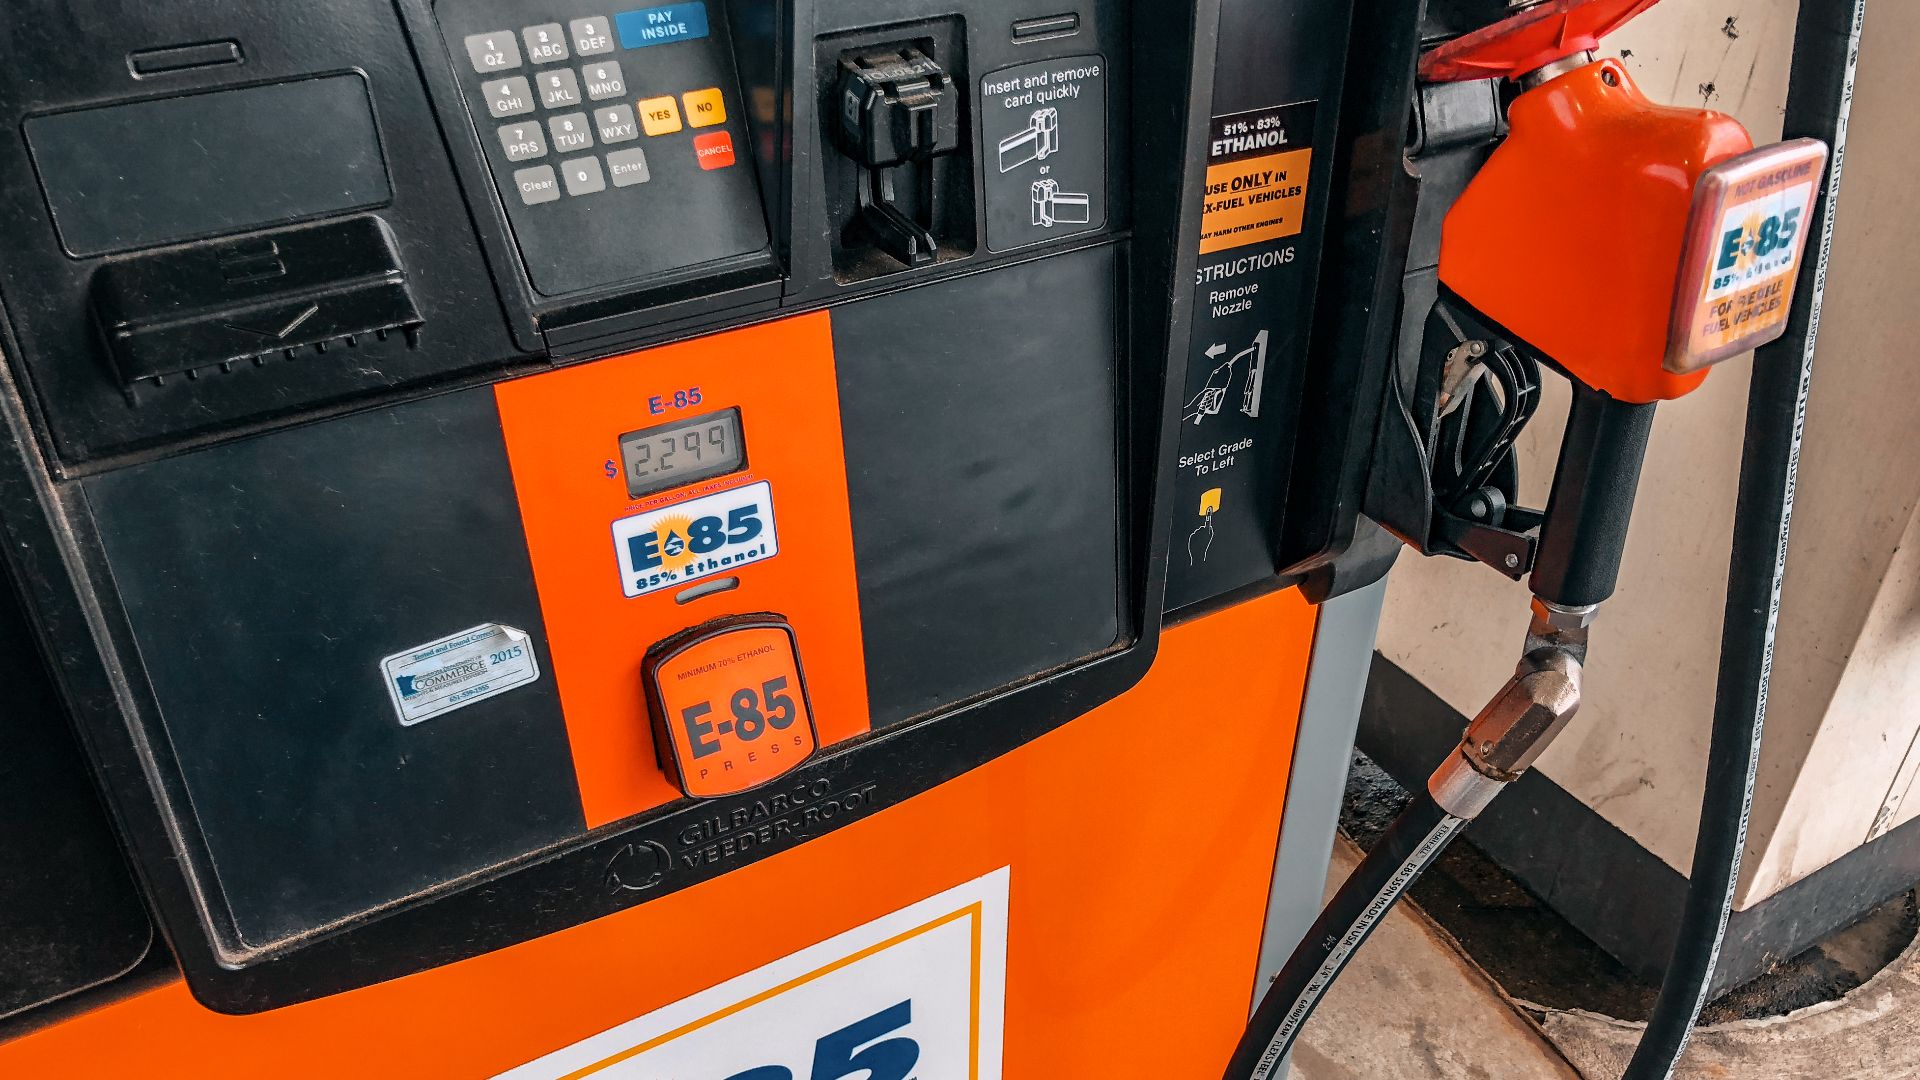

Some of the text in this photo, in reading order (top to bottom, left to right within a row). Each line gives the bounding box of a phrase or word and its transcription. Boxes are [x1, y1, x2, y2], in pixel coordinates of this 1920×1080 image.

[649, 11, 673, 24] PAY
[539, 32, 549, 43] 2
[586, 24, 594, 35] 3
[642, 23, 688, 40] INSIDE
[486, 40, 495, 50] 1
[533, 44, 562, 58] ABC
[580, 37, 606, 51] DEF
[485, 53, 505, 66] QZ
[552, 77, 561, 88] 5
[599, 69, 607, 80] 6
[984, 65, 1100, 96] Insert and remove
[502, 85, 511, 95] 4
[548, 90, 573, 103] JKL
[590, 81, 622, 95] MNO
[1005, 83, 1081, 108] card quickly
[497, 98, 523, 112] GHI
[697, 102, 713, 113] NO
[609, 113, 618, 123] 9
[649, 109, 671, 121] YES
[564, 121, 573, 131] 8
[603, 124, 632, 138] WXY
[1224, 122, 1248, 136] 51%
[1256, 116, 1281, 130] 83%
[516, 130, 523, 140] 7
[559, 134, 585, 147] TUV
[1212, 129, 1288, 157] ETHANOL
[510, 142, 539, 155] PRS
[698, 145, 733, 158] CANCEL
[578, 171, 587, 182] 0
[613, 162, 642, 175] Enter
[1039, 165, 1050, 174] or
[522, 180, 553, 192] Clear
[1230, 170, 1273, 191] ONLY
[1275, 171, 1287, 182] IN
[1248, 186, 1302, 205] VEHICLES
[1825, 196, 1836, 235] MADE
[1834, 145, 1844, 174] USA
[1213, 228, 1232, 237] HARM
[1233, 222, 1255, 233] OTHER
[1255, 217, 1284, 229] ENGINES
[1209, 283, 1259, 304] Remove
[1212, 299, 1252, 319] Nozzle
[648, 387, 702, 415] E-85
[1795, 357, 1812, 442] FUTURA
[635, 425, 725, 477] 2.299
[1179, 437, 1253, 468] Select Grade
[605, 459, 618, 479] $
[1195, 456, 1235, 477] To Left
[636, 543, 766, 590] 85% Ethanol
[413, 630, 496, 661] Tested and Found Correct
[489, 646, 523, 666] 2015
[677, 644, 775, 681] MINIMUM 70% ETHANOL
[415, 660, 487, 691] COMMERCE
[681, 675, 796, 760] E-85
[700, 735, 803, 780] PRESS
[679, 777, 831, 846] GILBARCO
[681, 784, 877, 871] VEEDER-ROOT
[1401, 862, 1417, 878] E85
[1383, 877, 1405, 897] 559N
[1364, 897, 1389, 920] MADE
[1355, 920, 1369, 930] IN
[1343, 930, 1362, 946] USA
[1279, 999, 1308, 1037] GOODYEAR
[1257, 1041, 1283, 1075] FLEXSTEEL
